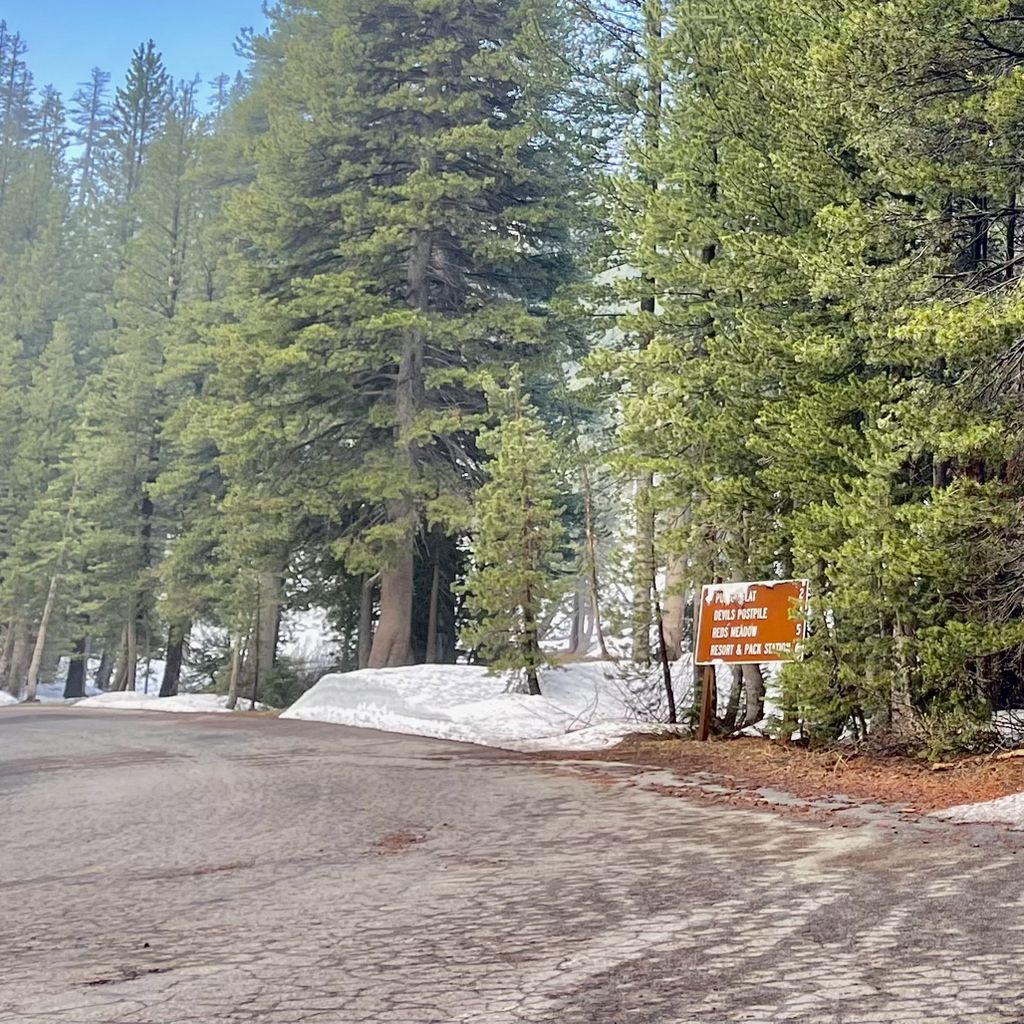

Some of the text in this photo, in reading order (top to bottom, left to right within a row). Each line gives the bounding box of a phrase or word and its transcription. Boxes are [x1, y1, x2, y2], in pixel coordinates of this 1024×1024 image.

[714, 607, 768, 622] DEVILS POSTPILE
[730, 625, 758, 638] MEADOW
[796, 624, 802, 636] 5
[710, 643, 735, 656] RESORT
[736, 643, 742, 655] &
[744, 642, 762, 655] PACK
